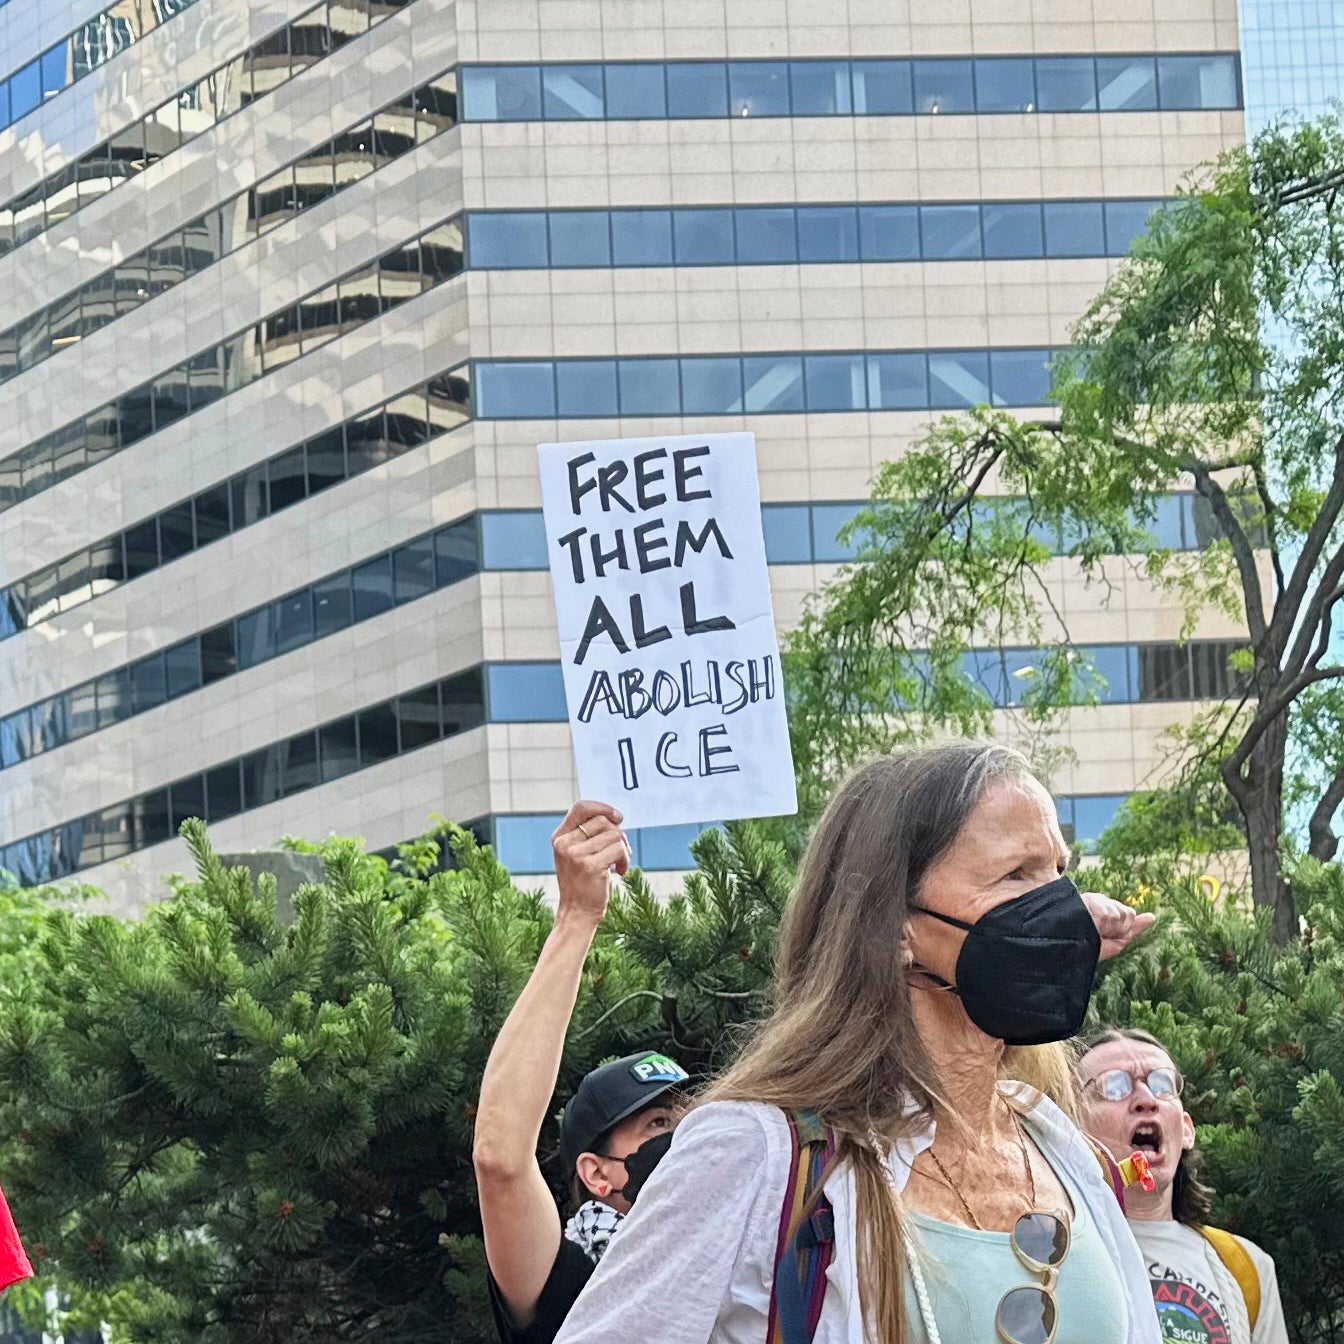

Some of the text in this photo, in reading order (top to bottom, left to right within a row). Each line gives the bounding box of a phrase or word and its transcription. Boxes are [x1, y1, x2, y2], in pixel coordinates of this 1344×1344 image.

[567, 445, 712, 515] FREE
[558, 518, 735, 584] THEM
[573, 581, 736, 665] ALL
[577, 655, 775, 723] ABOLISH
[618, 724, 740, 790] ICE
[1172, 1327, 1209, 1344] SIGUE
